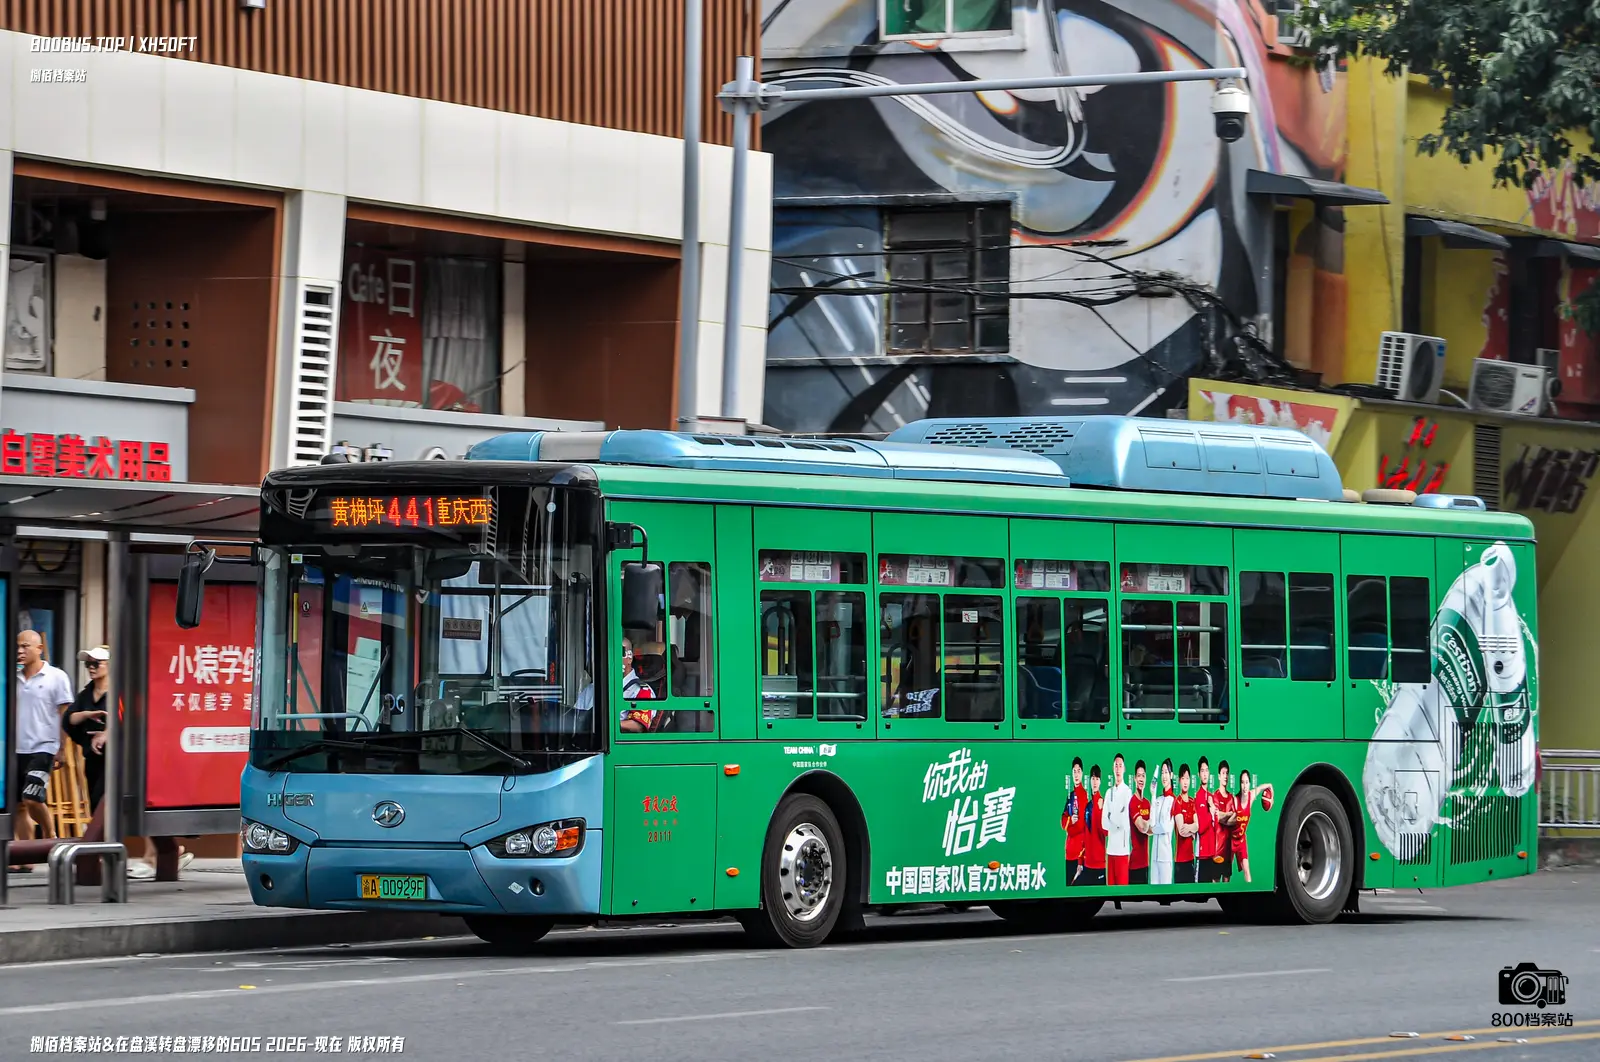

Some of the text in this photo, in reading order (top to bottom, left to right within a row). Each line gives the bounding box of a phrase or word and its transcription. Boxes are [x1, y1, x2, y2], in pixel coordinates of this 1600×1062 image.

[437, 497, 493, 525] 重庆西
[922, 747, 989, 803] 你我的
[267, 793, 314, 807] HIGER
[941, 786, 1017, 857] 怡寶
[885, 861, 1048, 896] 中国国家队官方饮用水
